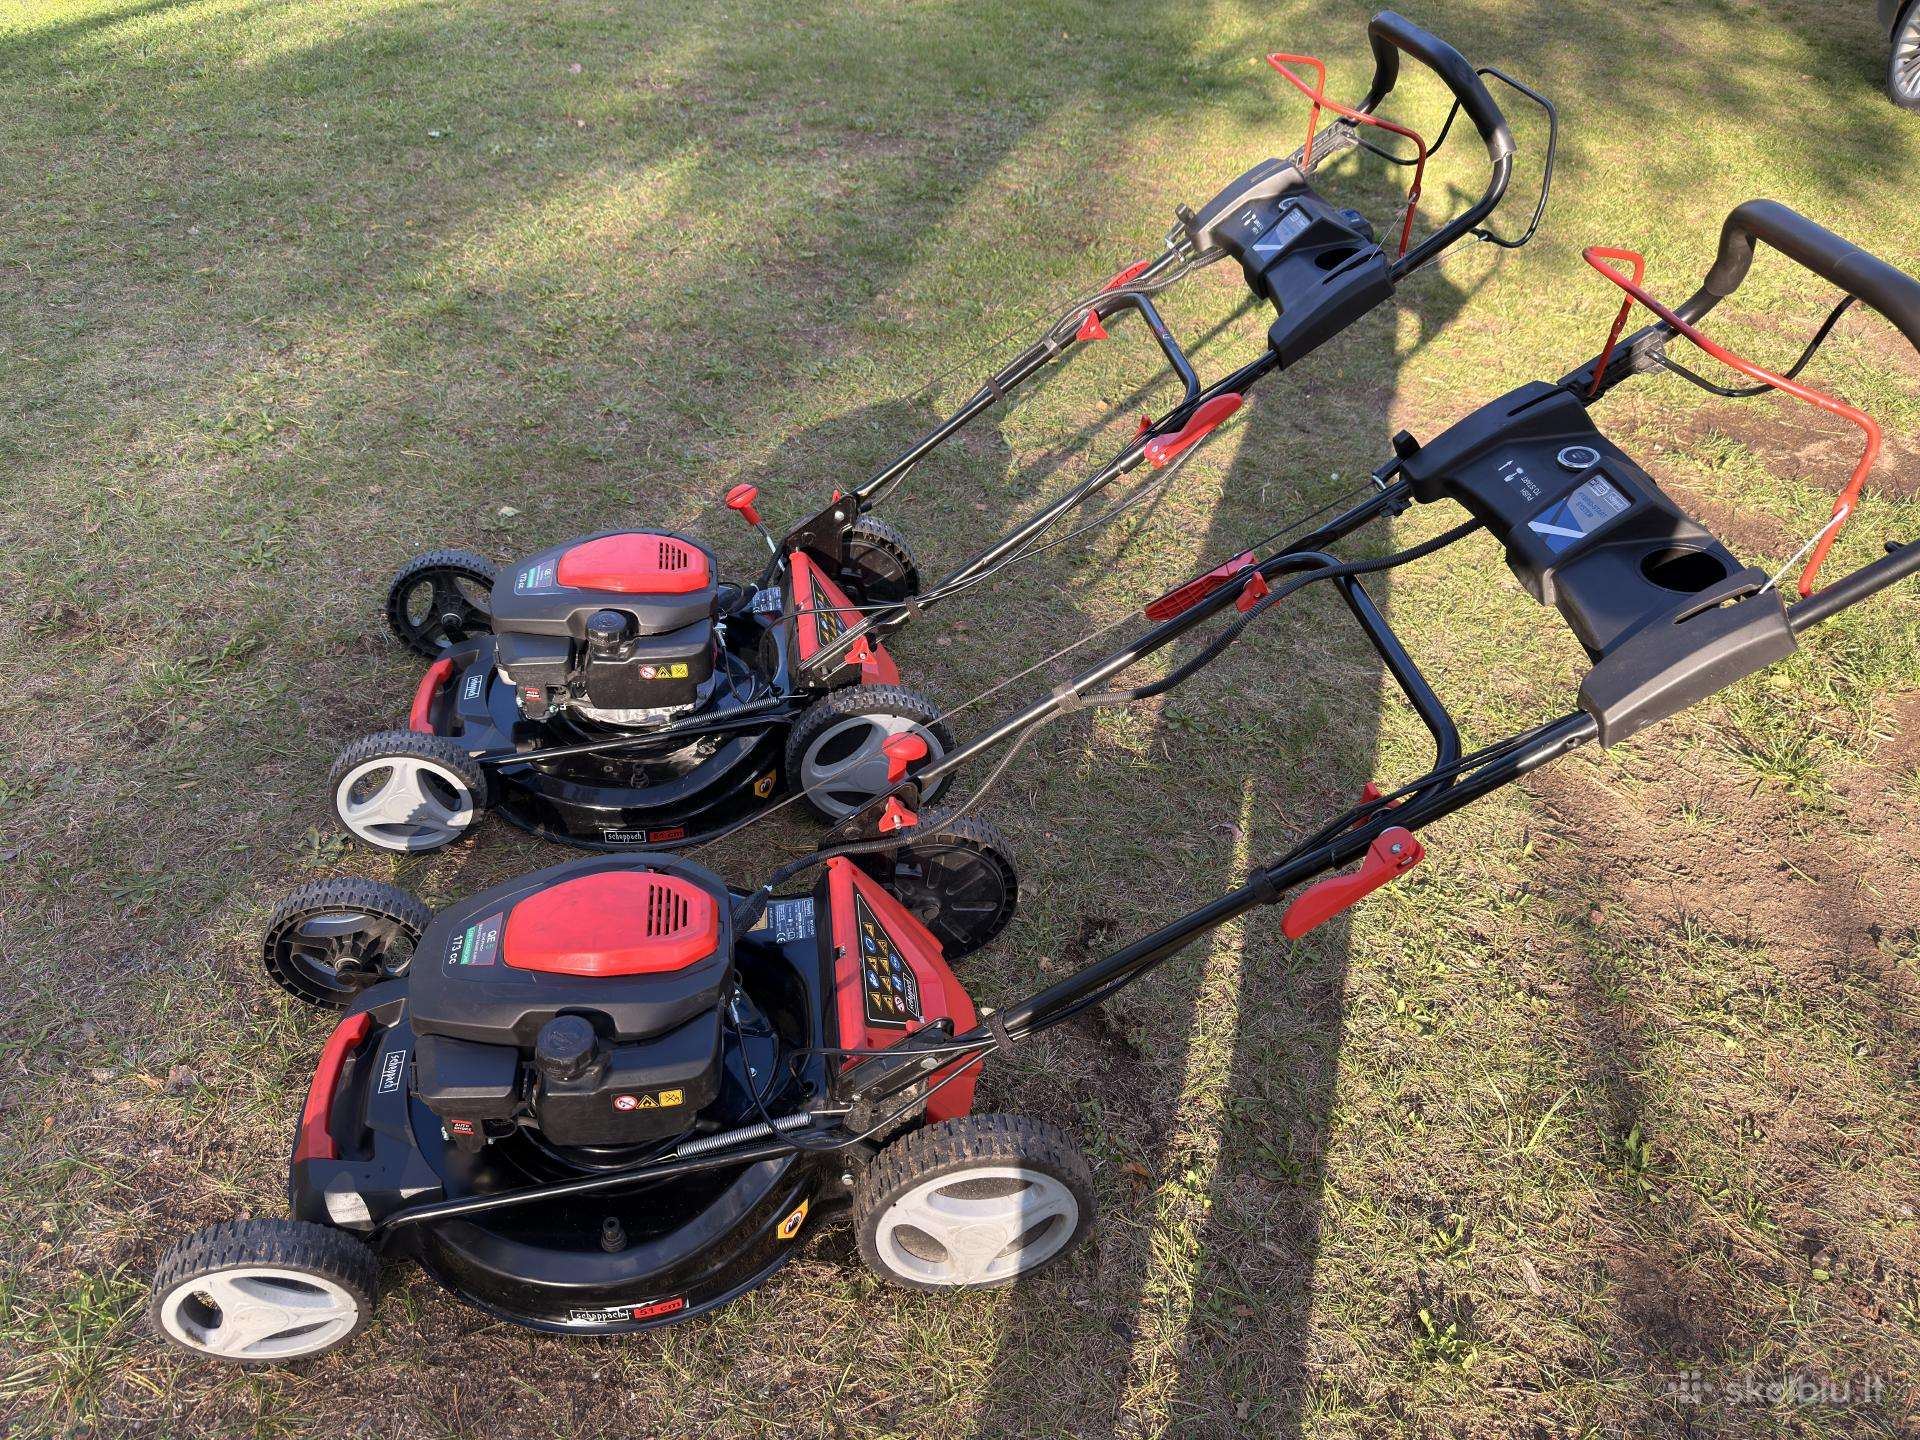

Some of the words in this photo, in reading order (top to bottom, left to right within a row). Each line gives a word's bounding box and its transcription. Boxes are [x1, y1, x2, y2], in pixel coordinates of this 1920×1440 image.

[1521, 476, 1537, 492] START
[451, 934, 464, 951] 173
[448, 952, 459, 965] cc
[640, 1307, 655, 1316] 51
[660, 1301, 682, 1312] cm
